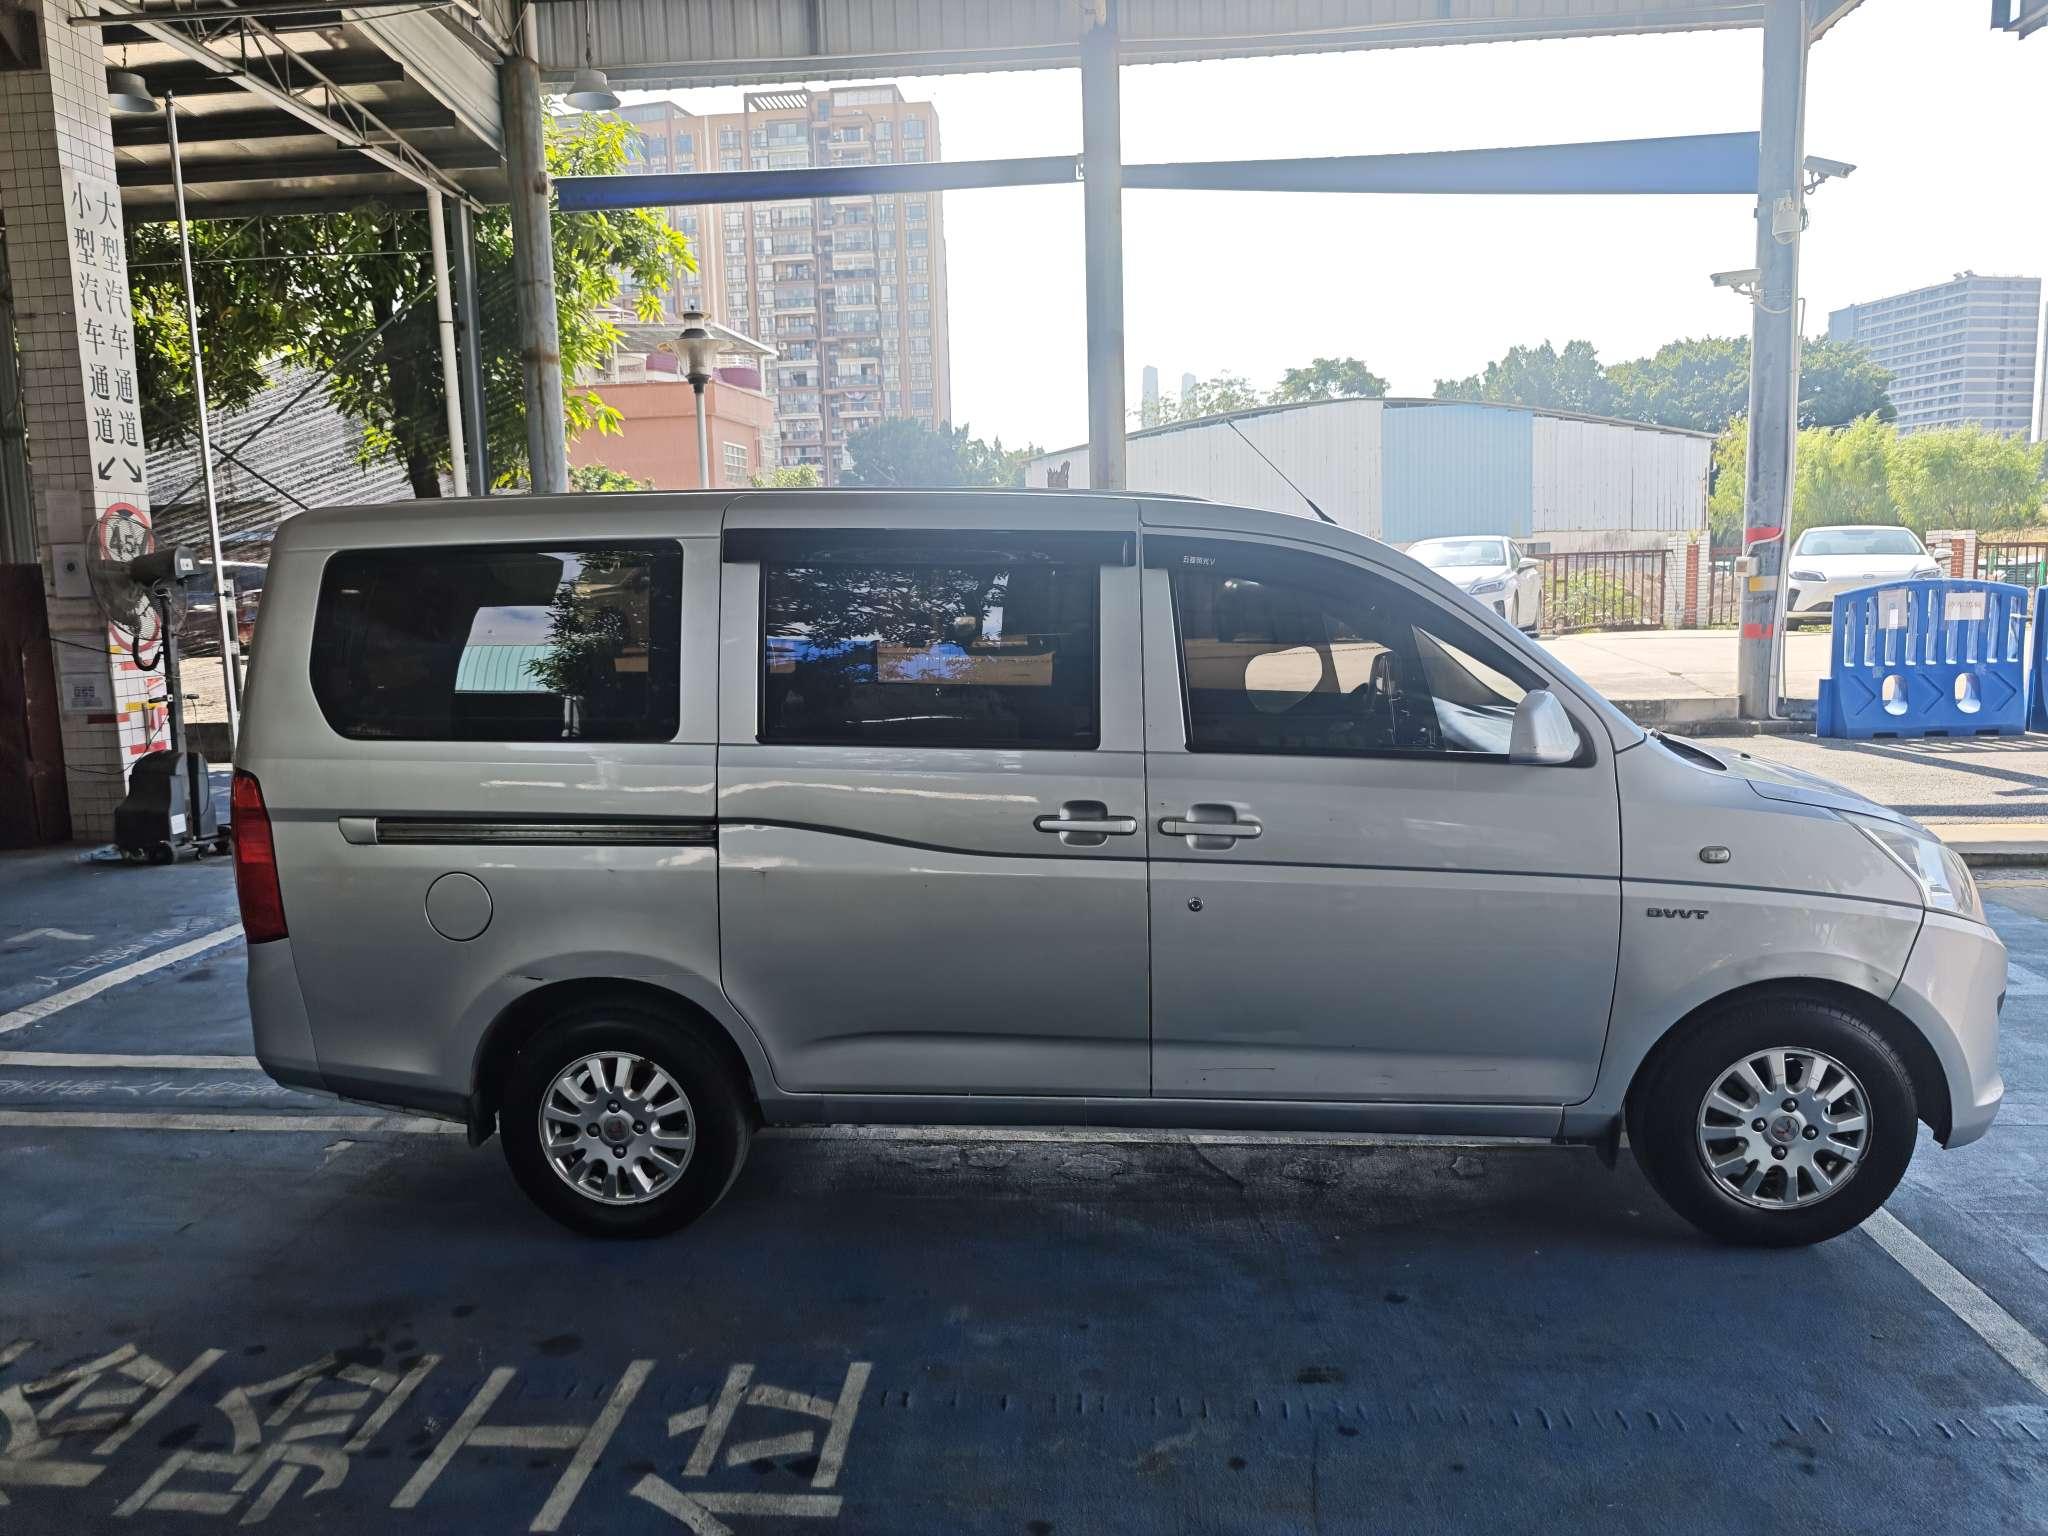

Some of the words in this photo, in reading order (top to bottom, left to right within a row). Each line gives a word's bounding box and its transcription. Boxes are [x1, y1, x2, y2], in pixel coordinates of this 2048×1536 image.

[71, 181, 115, 444] 小型汽车通道
[96, 191, 139, 448] 大型汽车通道
[1646, 907, 1709, 920] DVVT
